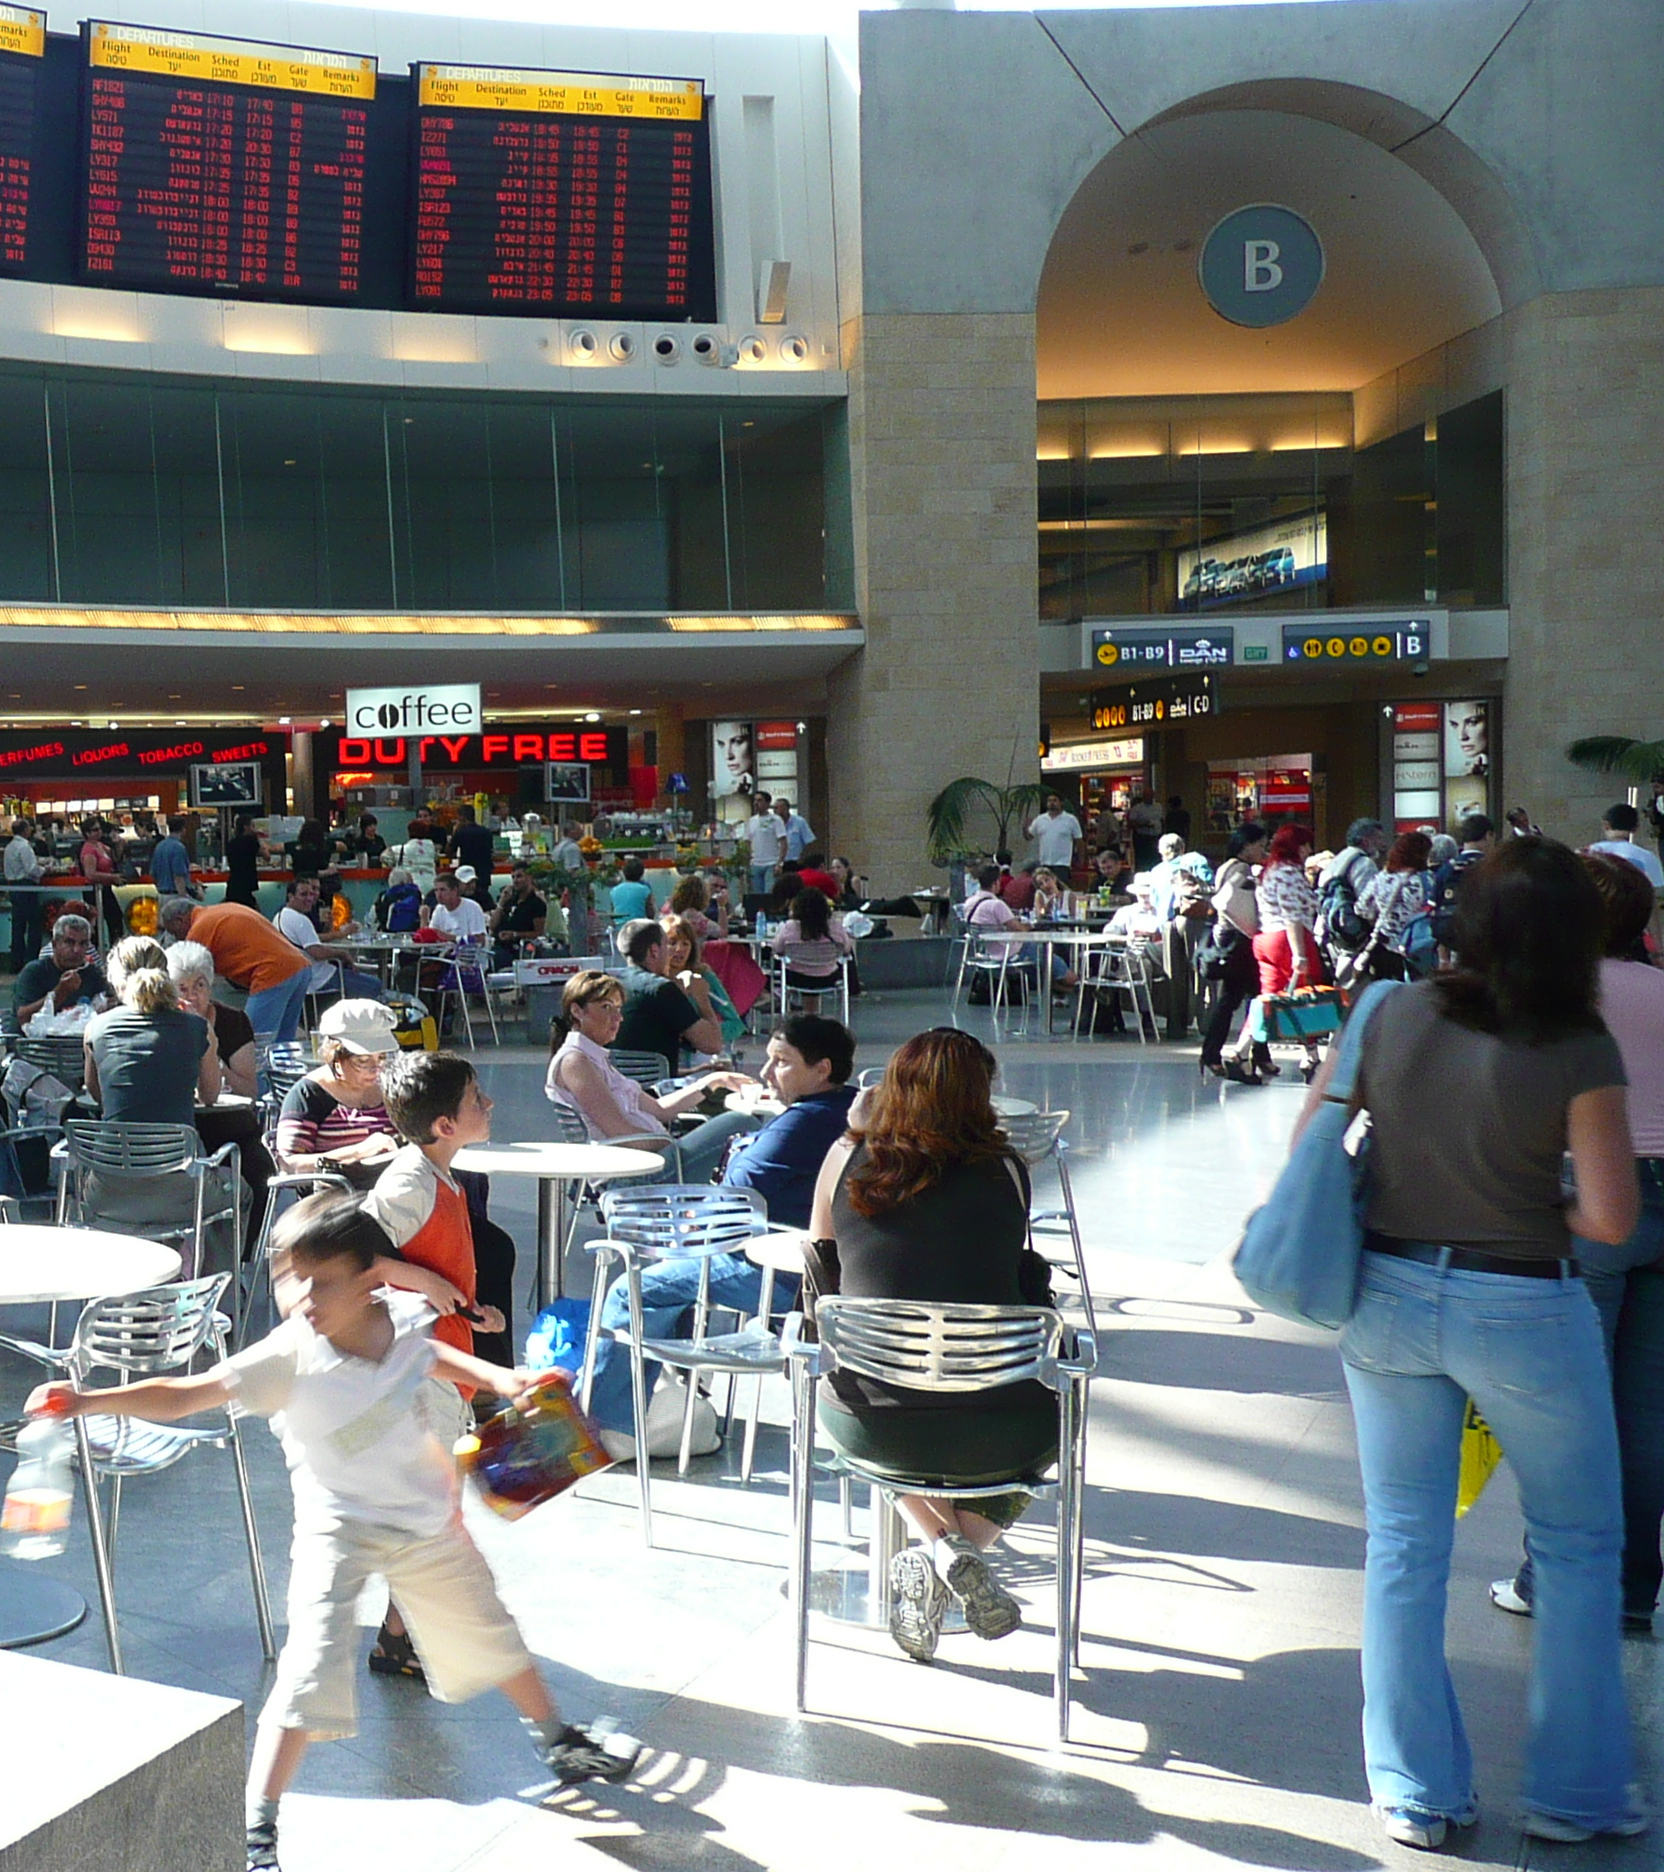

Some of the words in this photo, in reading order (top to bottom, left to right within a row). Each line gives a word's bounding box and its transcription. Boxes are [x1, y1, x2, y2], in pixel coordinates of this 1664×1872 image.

[117, 26, 195, 48] DEPARTURES
[102, 41, 132, 54] Flight
[148, 46, 201, 62] Destination
[212, 55, 240, 67] Sched
[258, 61, 272, 72] Est
[289, 65, 310, 77] Gate
[323, 69, 360, 83] Remarks
[446, 66, 522, 83] DEPARTURES
[431, 81, 459, 92] Flight
[476, 83, 527, 96] Destination
[539, 87, 566, 98] Sched
[584, 90, 597, 100] Est
[615, 92, 635, 102] Gate
[649, 94, 687, 105] Remarks
[1244, 239, 1284, 292] B
[1121, 645, 1165, 661] B1-B9
[1406, 635, 1422, 656] B
[355, 693, 474, 730] coffee
[72, 742, 131, 767] LIQUORS
[138, 741, 204, 766] TOBACCO
[211, 741, 268, 764] SWEETS
[482, 732, 608, 762] FREE
